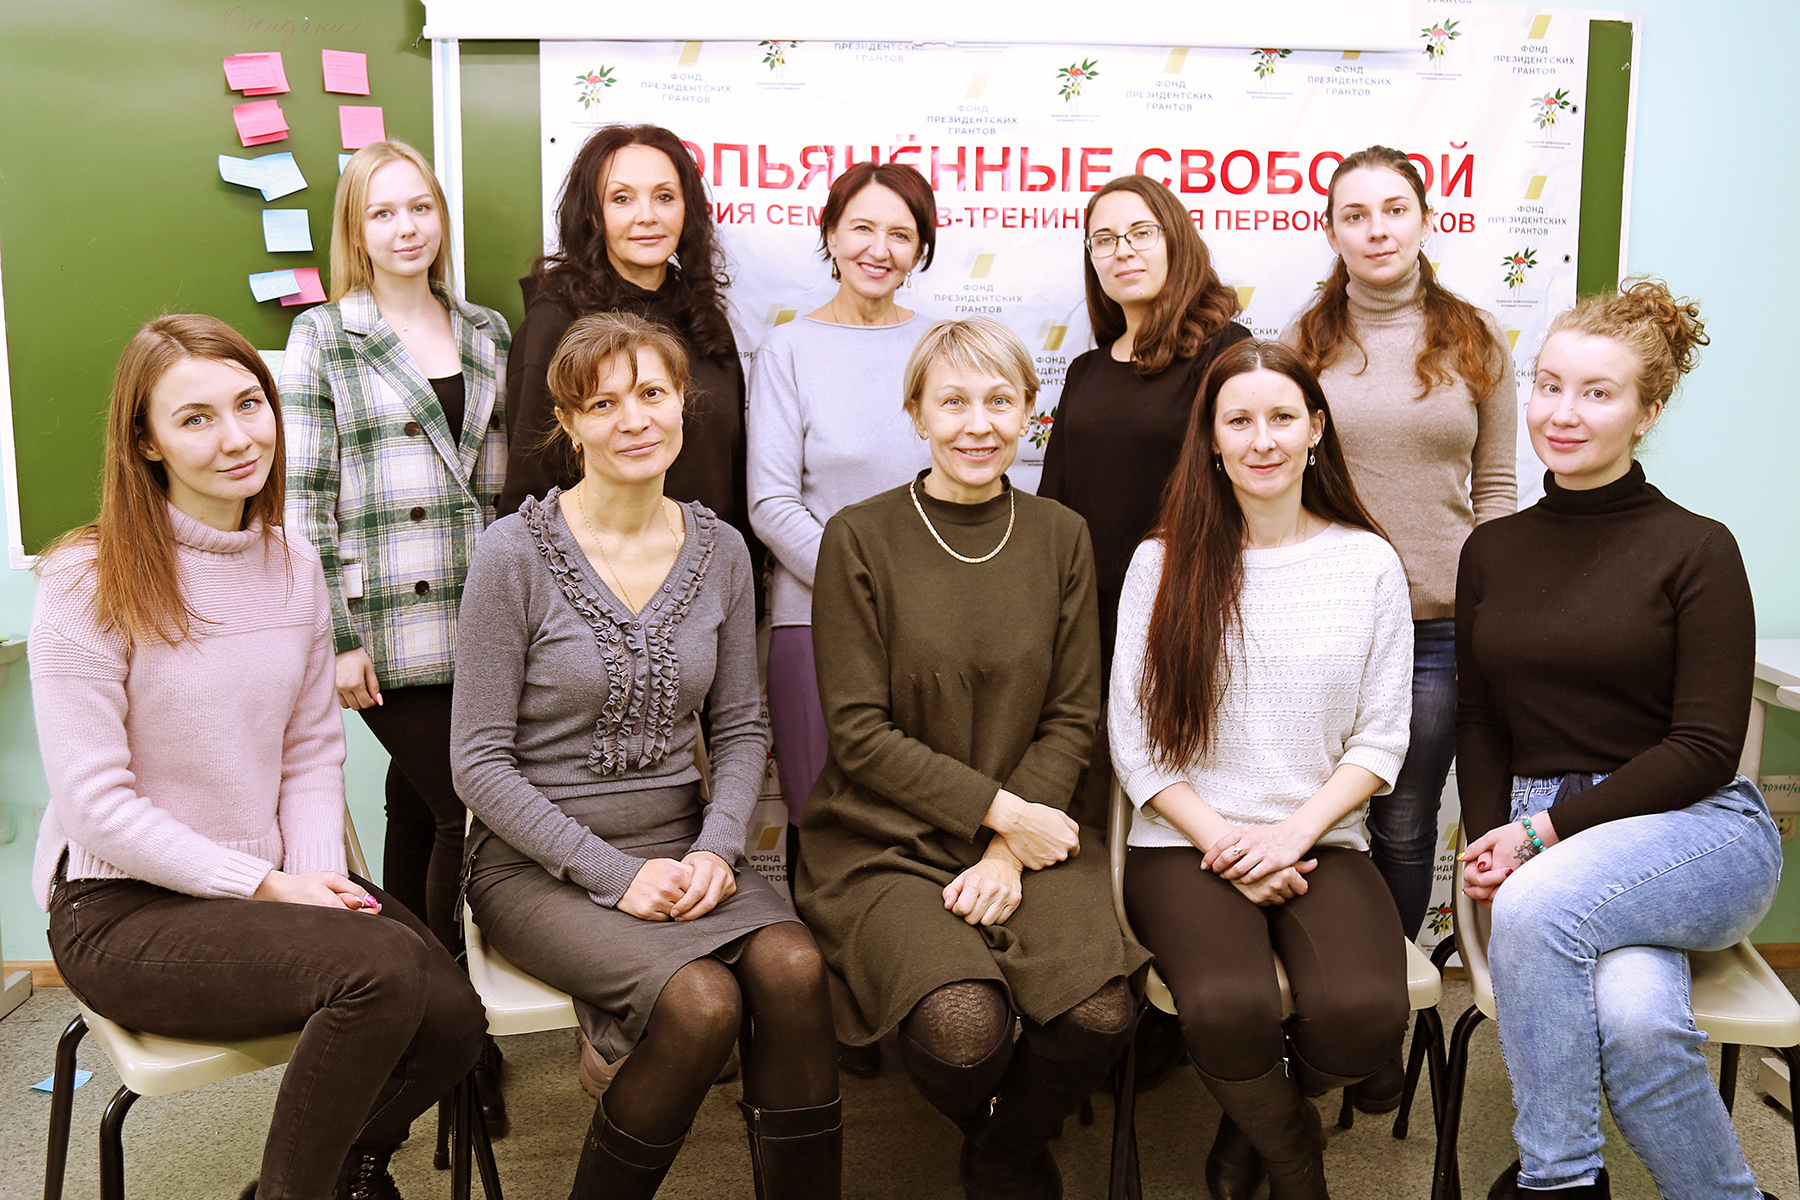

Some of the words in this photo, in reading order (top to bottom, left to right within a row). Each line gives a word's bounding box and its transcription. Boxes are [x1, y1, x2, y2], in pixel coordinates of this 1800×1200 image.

[834, 42, 926, 52] ПРЕЗИДЕНТСК
[1520, 45, 1549, 54] ФОНД
[856, 54, 905, 63] ГРАНТОВ
[1493, 55, 1575, 66] ПРЕЗИДЕНТСКИХ
[1334, 65, 1364, 76] ФОНД
[1512, 67, 1556, 76] ГРАНТОВ
[670, 73, 703, 82] ФОНД
[1307, 76, 1392, 86] ПРЕЗИДЕНТСКИХ
[640, 81, 732, 93] ПРЕЗИДЕНТСКИХ
[1155, 80, 1187, 89] ФОНД
[1126, 90, 1214, 101] ПРЕЗИДЕНТСКИХ
[1326, 87, 1371, 97] ГРАНТОВ
[662, 94, 711, 104] ГРАНТОВ
[957, 105, 989, 114] ФОНД
[1146, 102, 1193, 112] ГРАНТОВ
[927, 116, 1018, 125] ПРЕЗИДЕНТСКИХ
[948, 127, 996, 136] ГРАНТОВ
[1135, 141, 1474, 198] СВОБООЙ
[1517, 205, 1545, 215] ФОНД
[1215, 209, 1476, 233] ПЕРВОКОВ
[1488, 216, 1568, 226] ПРЕЗИДЕНТСКИХ
[1509, 227, 1549, 236] ГРАНТОВ
[962, 284, 995, 294] ФОНД
[934, 294, 1024, 303] ПРЕЗИДЕНТСКИХ
[955, 305, 1003, 314] ГРАНТОВ
[1232, 316, 1253, 326] ОНД
[1035, 356, 1067, 365] ФОНД
[1040, 378, 1067, 386] АНТО
[750, 854, 781, 863] ФОНД
[1439, 854, 1454, 862] ФО
[762, 873, 788, 882] НТОВ
